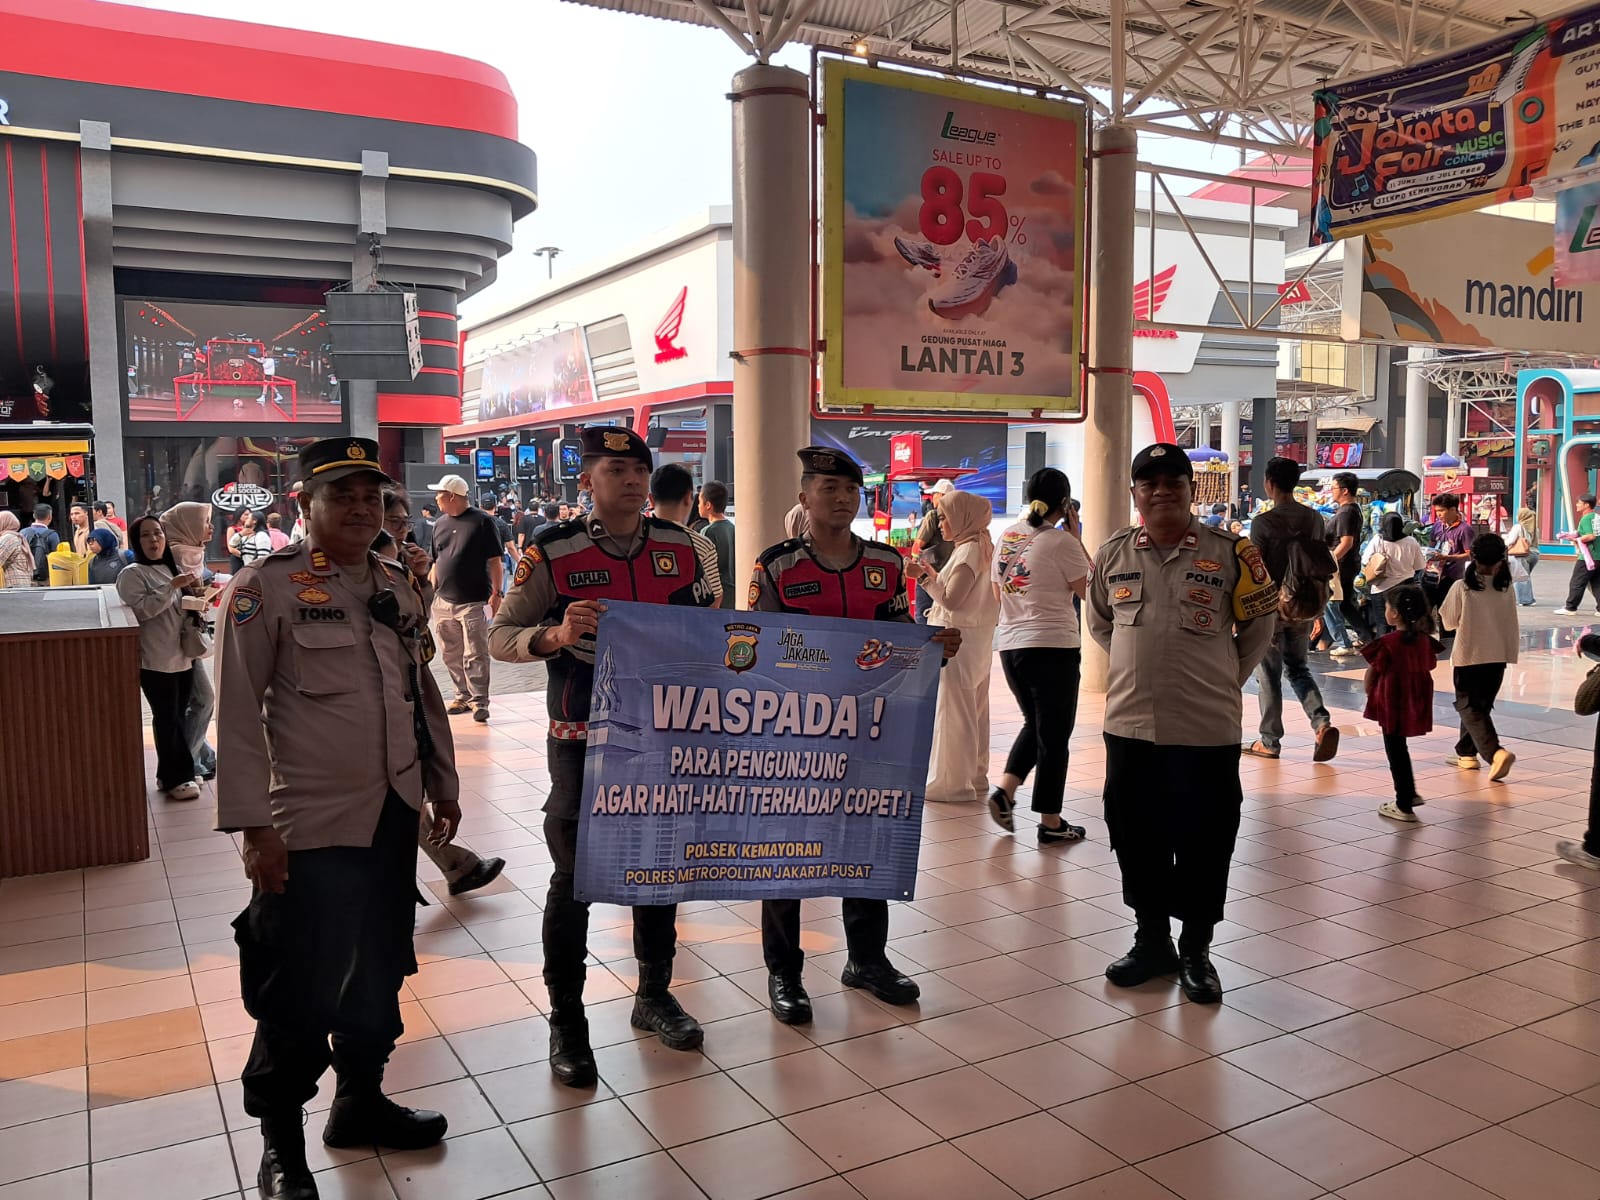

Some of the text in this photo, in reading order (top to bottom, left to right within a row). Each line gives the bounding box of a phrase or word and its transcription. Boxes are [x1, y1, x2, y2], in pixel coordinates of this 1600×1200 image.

[941, 111, 997, 143] League
[1558, 119, 1584, 133] THE
[1336, 107, 1476, 176] Jakarta
[1455, 130, 1504, 156] MUSIC
[932, 148, 1002, 170] SALE UP TO
[1373, 141, 1452, 193] Fair
[1444, 148, 1496, 168] CONCERT
[1465, 276, 1583, 323] mandiri
[921, 335, 1007, 348] GEDUNG PUSAT NIAGA
[901, 345, 1025, 377] LANTAI 3
[1490, 482, 1504, 490] 100%
[219, 494, 268, 506] ZONE
[1185, 572, 1224, 588] POLRI
[300, 608, 346, 621] TONO
[726, 624, 745, 632] METRO
[777, 629, 804, 647] JAGA
[652, 684, 885, 739] WASPADA !
[670, 746, 848, 780] PARA PENGUNJUNG
[592, 784, 649, 815] AGAR
[652, 783, 747, 815] HATI-HATI
[750, 785, 842, 816] TERHADAP
[685, 842, 822, 860] POLSEK KEMAYORAN
[625, 864, 873, 885] POLRES METROPOLITAN JAKARTA PUSAT
